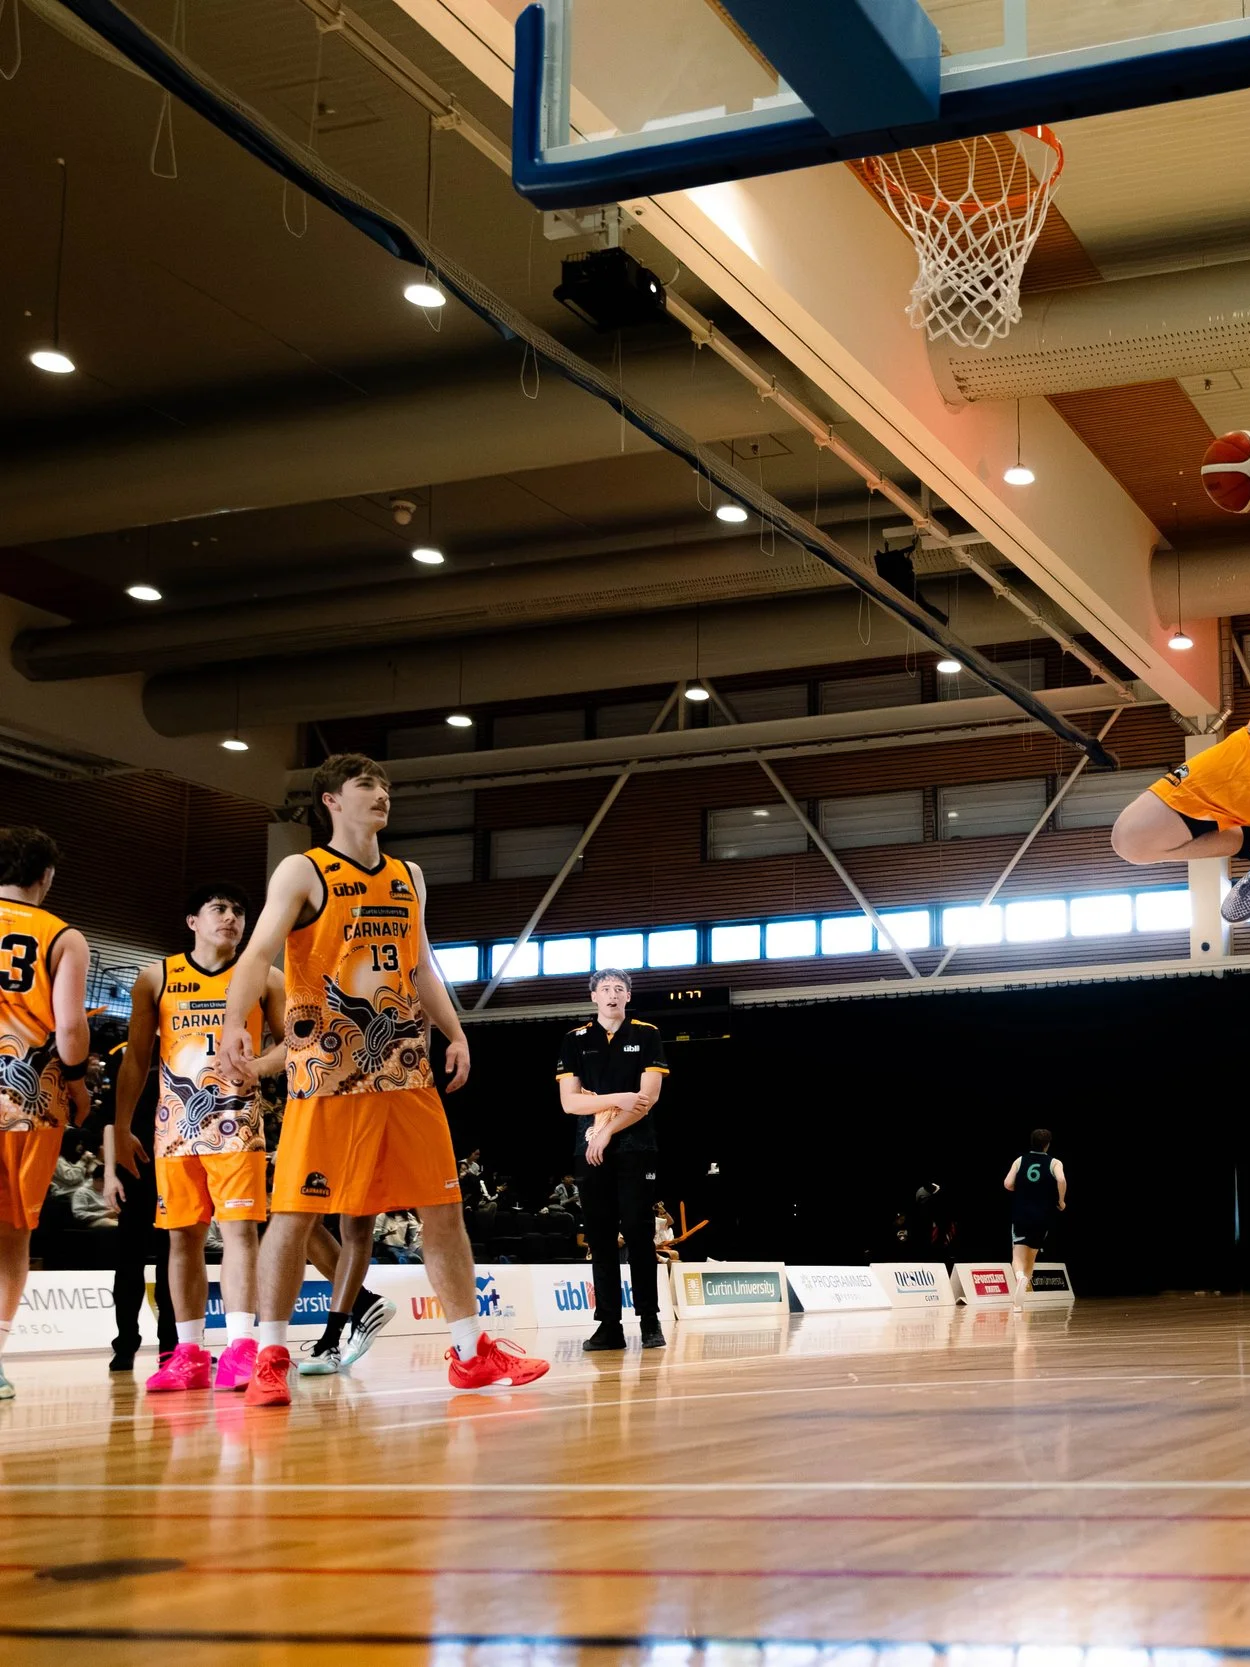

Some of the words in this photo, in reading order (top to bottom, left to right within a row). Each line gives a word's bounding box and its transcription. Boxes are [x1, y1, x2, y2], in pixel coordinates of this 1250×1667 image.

[344, 922, 411, 942] CARNABY
[0, 933, 39, 992] 3
[370, 944, 399, 972] 13
[172, 1014, 226, 1031] CARNA
[206, 1033, 216, 1056] 1
[1027, 1163, 1041, 1182] 6
[811, 1275, 872, 1288] PROGRAMMED
[894, 1267, 935, 1287] nesuto
[706, 1280, 733, 1297] Curtin
[734, 1279, 775, 1297] University
[9, 1323, 63, 1335] RSOL
